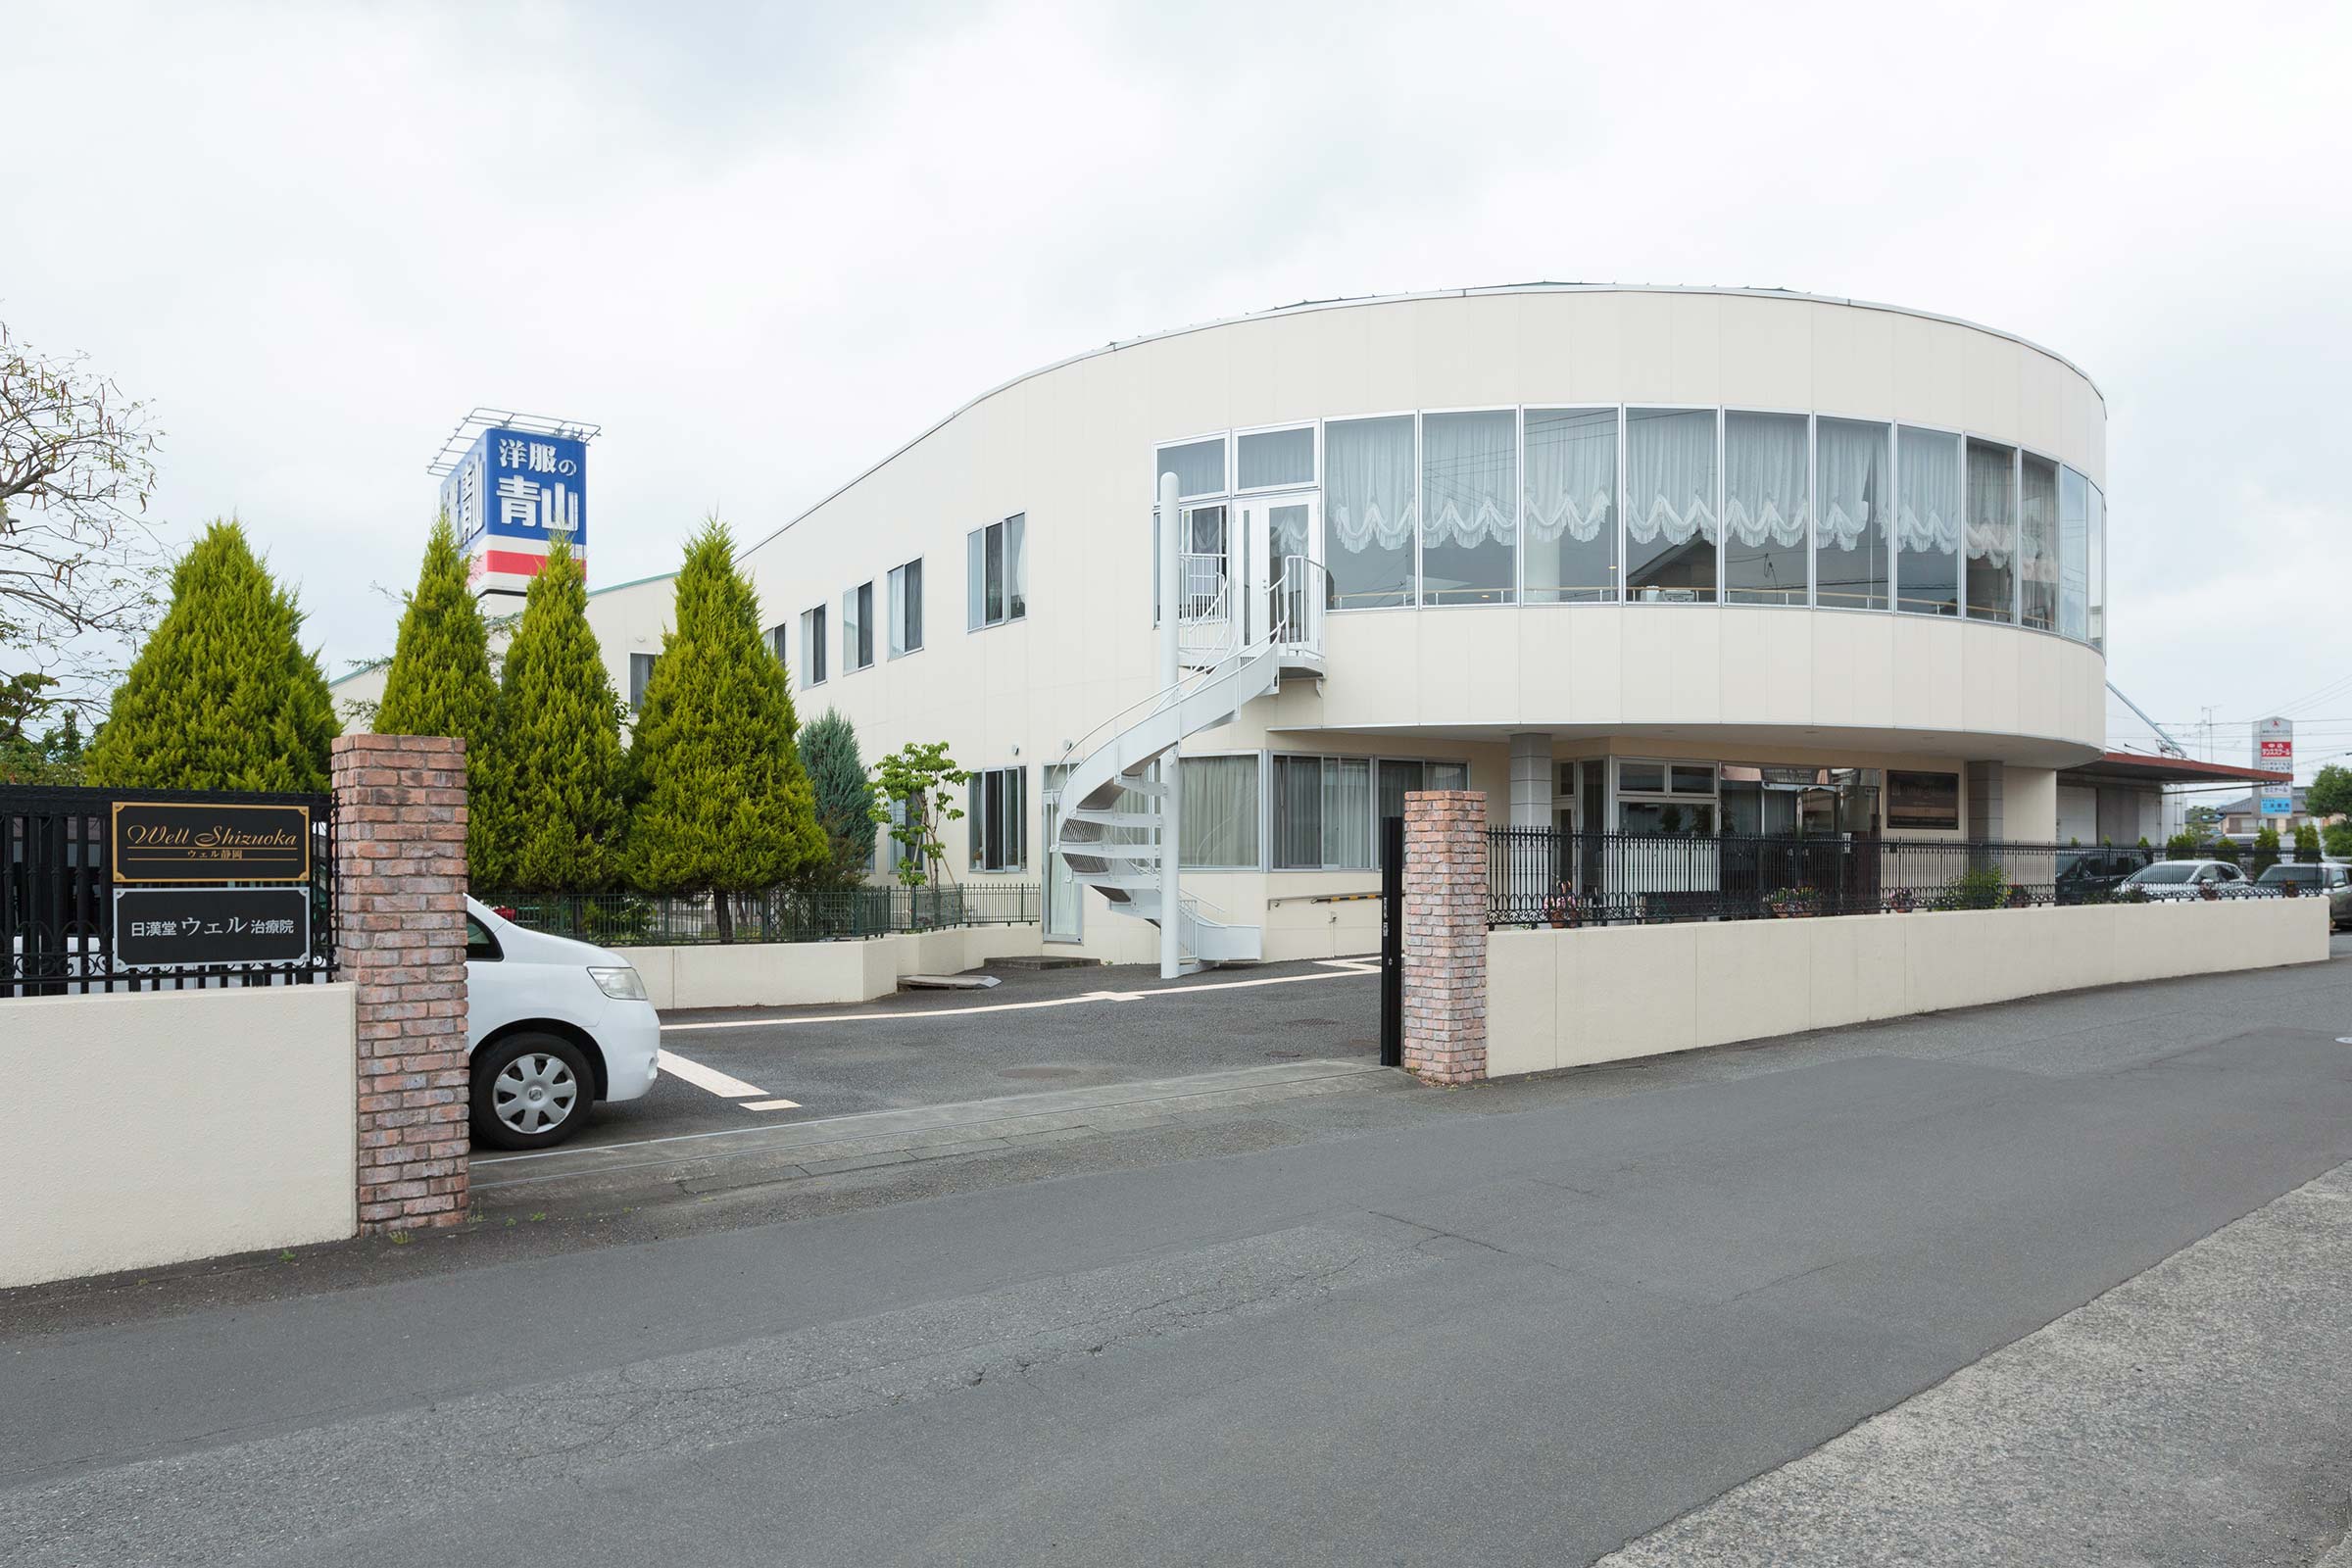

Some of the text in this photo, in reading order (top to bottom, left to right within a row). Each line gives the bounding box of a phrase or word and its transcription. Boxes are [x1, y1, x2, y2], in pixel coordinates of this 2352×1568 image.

[498, 438, 577, 476] 洋服の
[496, 474, 579, 532] 青山
[127, 824, 298, 848] Well Shizuoka
[187, 849, 243, 859] ウェル静岡
